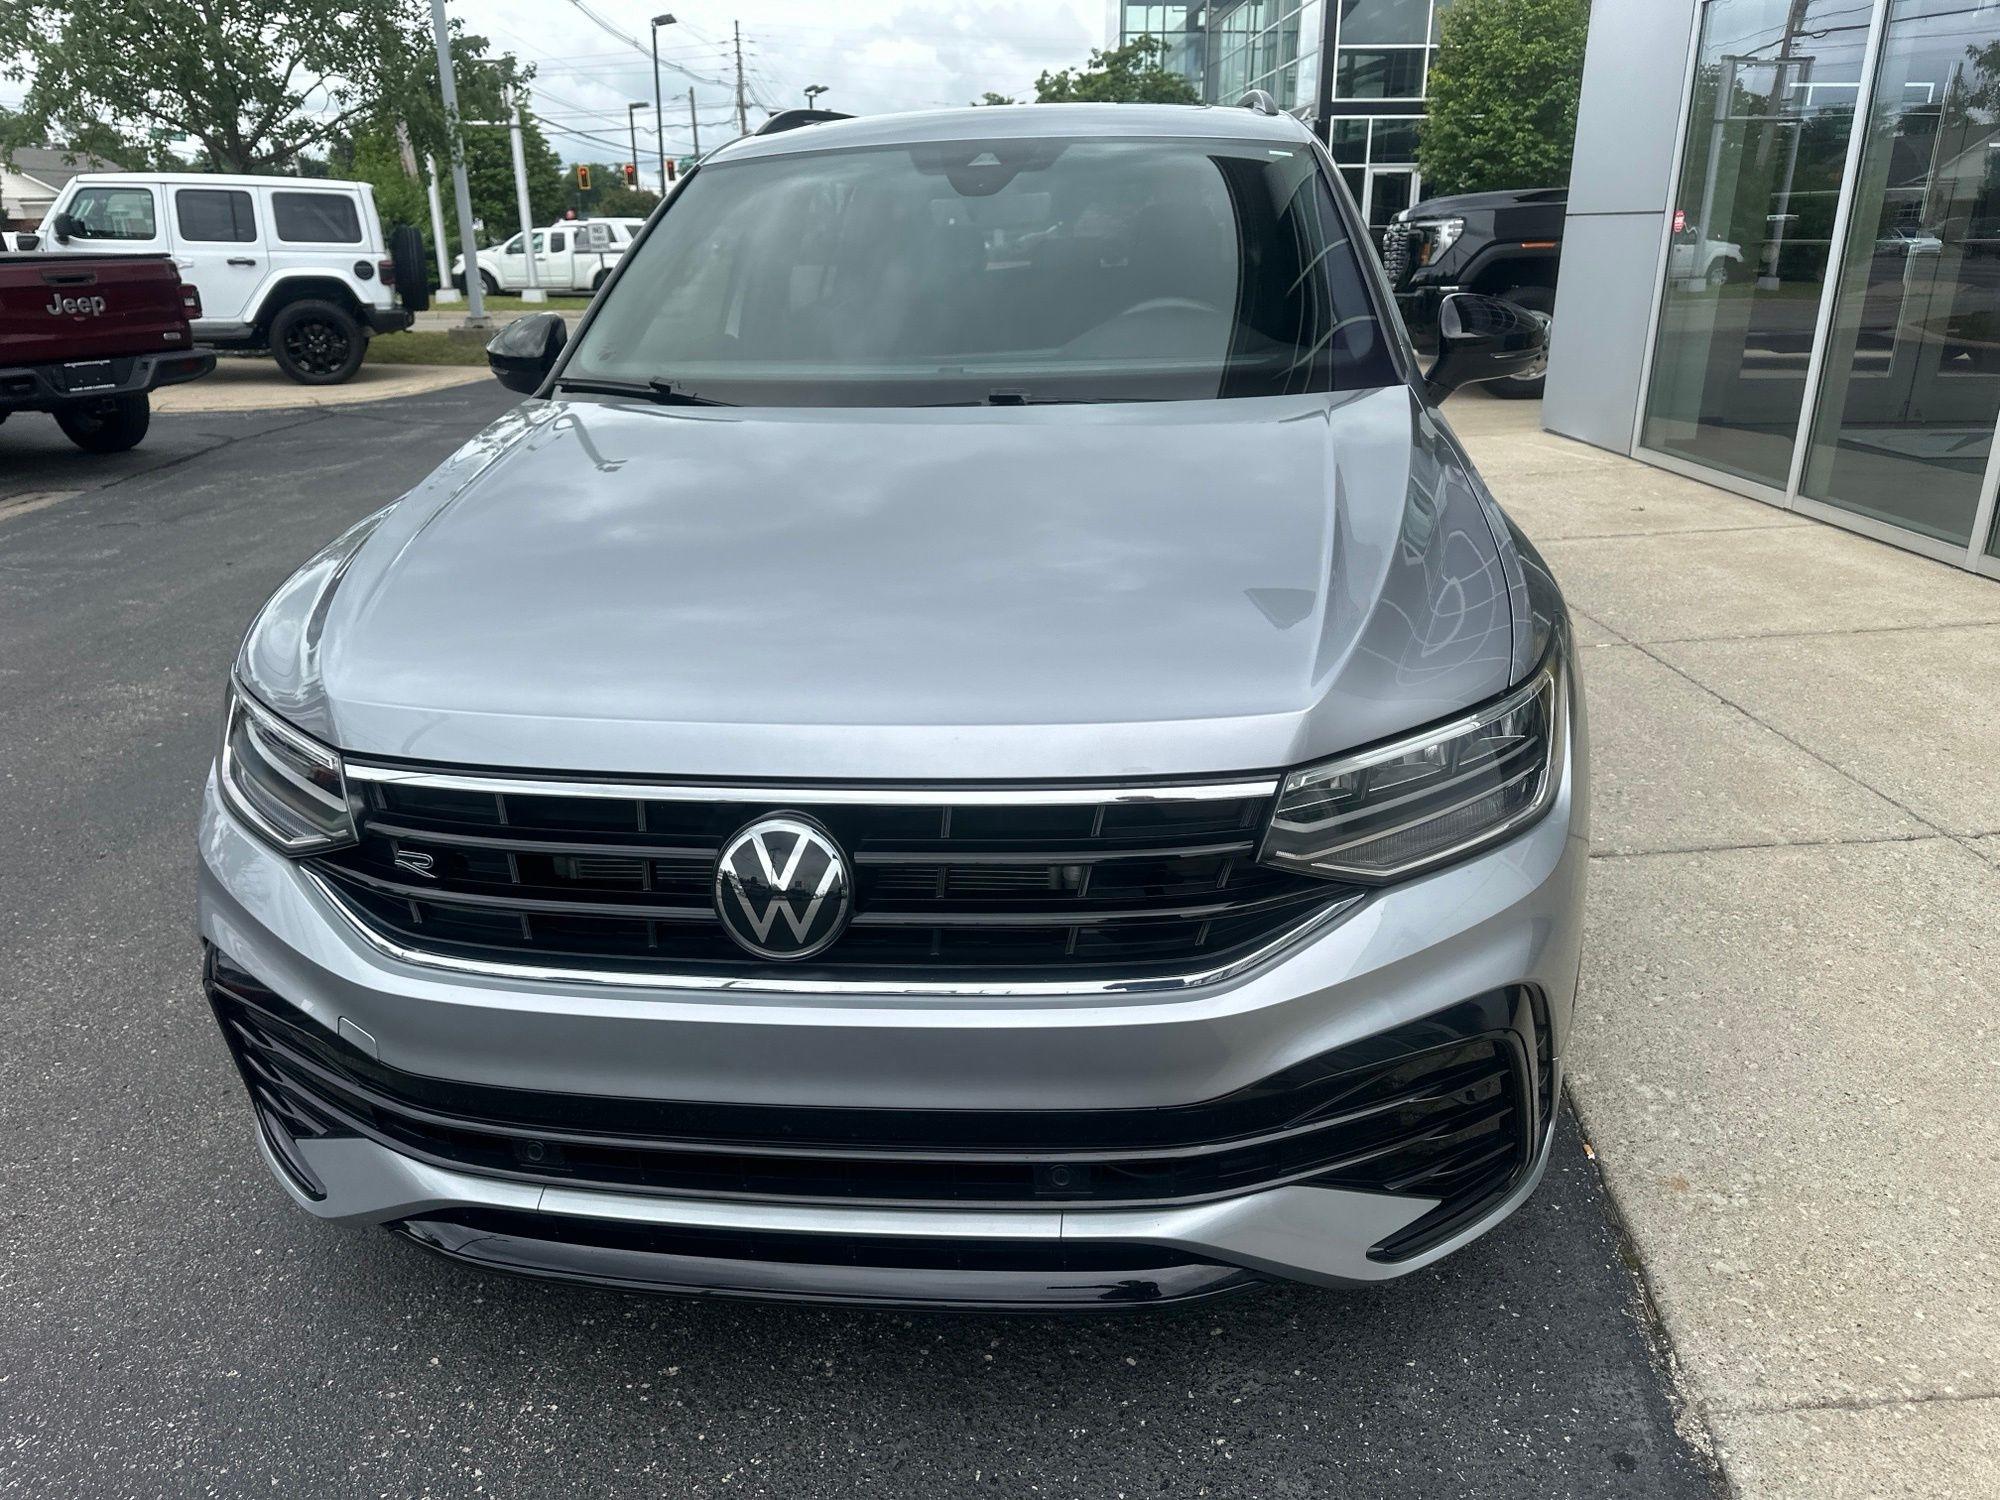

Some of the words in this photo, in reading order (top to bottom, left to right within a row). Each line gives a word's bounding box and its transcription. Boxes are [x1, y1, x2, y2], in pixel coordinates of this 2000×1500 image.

[46, 293, 106, 316] Jeep
[395, 850, 437, 879] R
[716, 820, 848, 958] VW
